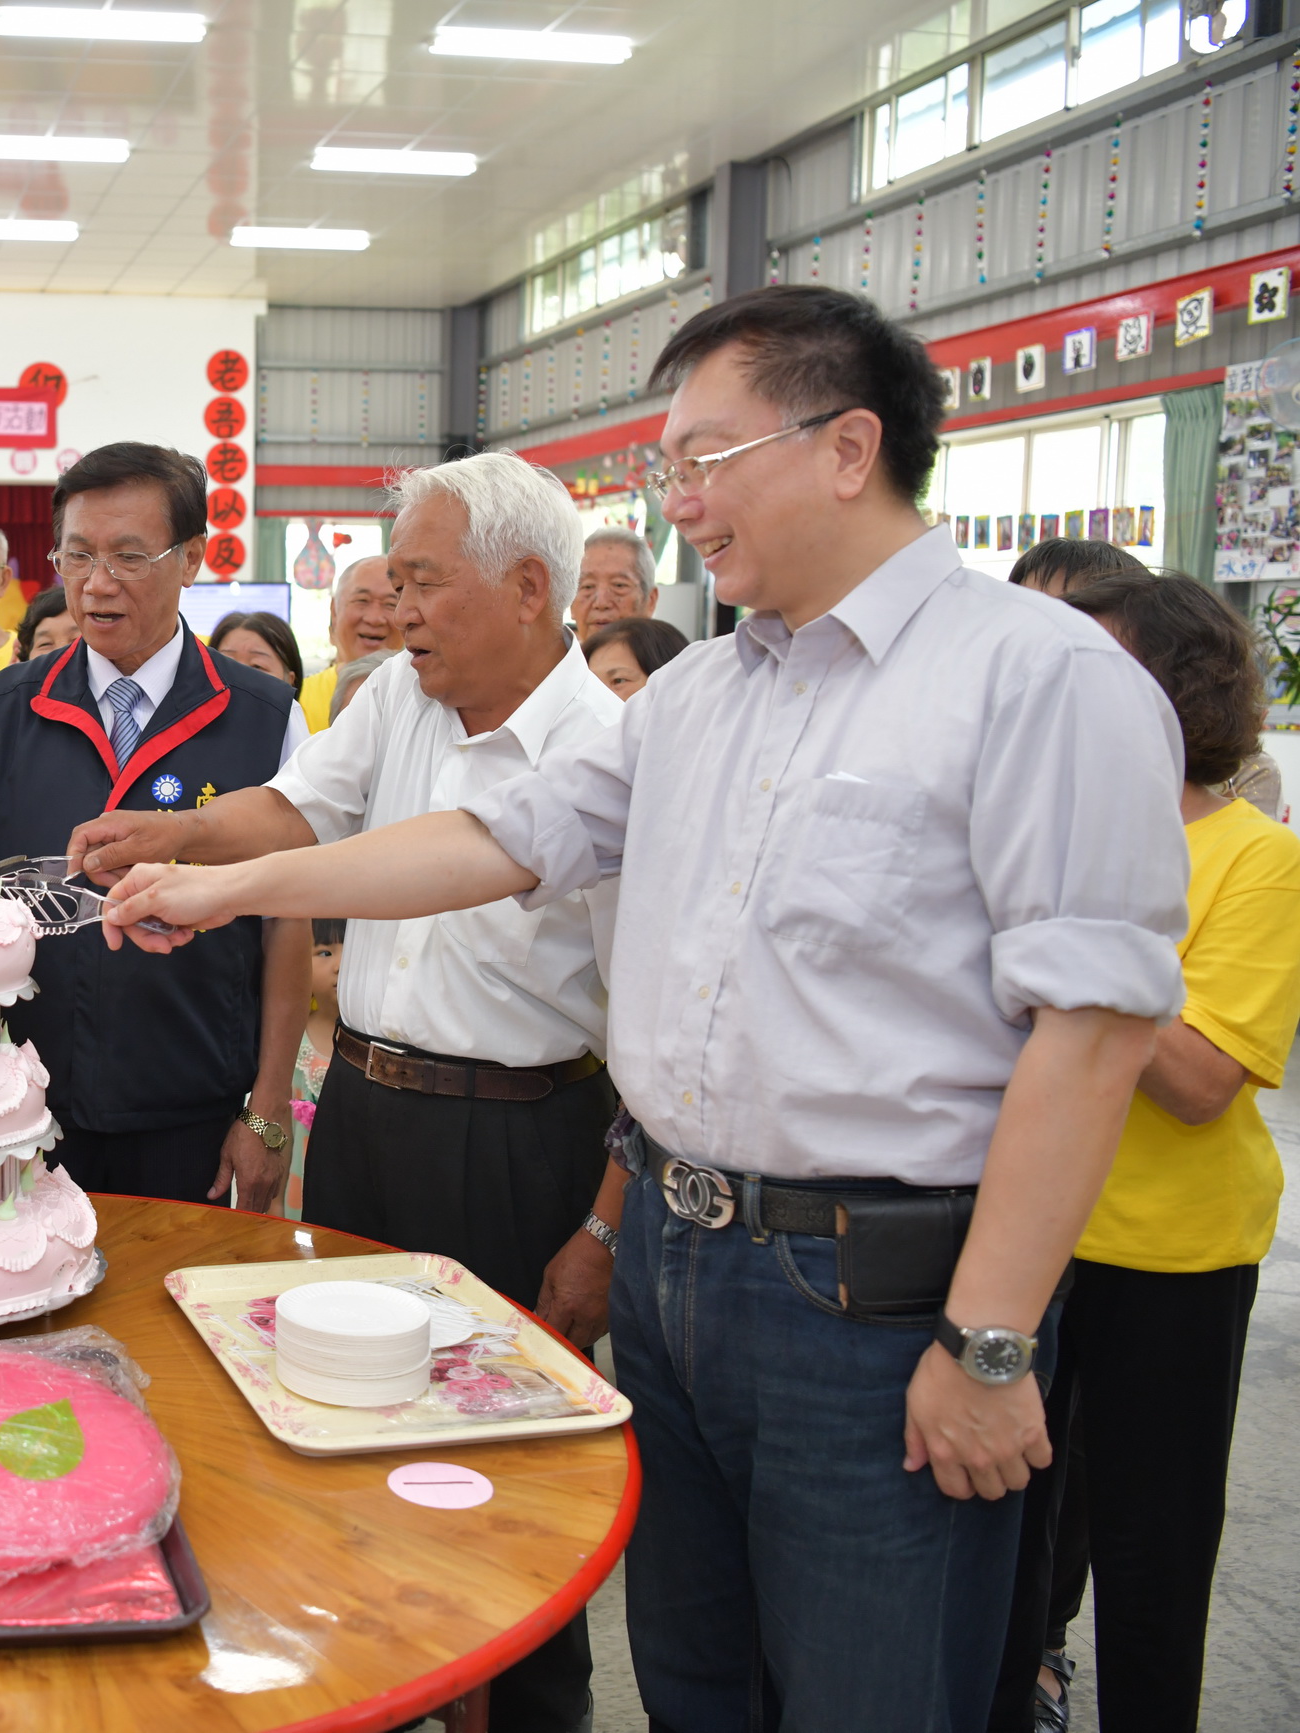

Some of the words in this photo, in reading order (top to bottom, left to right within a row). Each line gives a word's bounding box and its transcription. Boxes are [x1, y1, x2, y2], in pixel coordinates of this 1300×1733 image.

[210, 351, 243, 570] 老吾老以及
